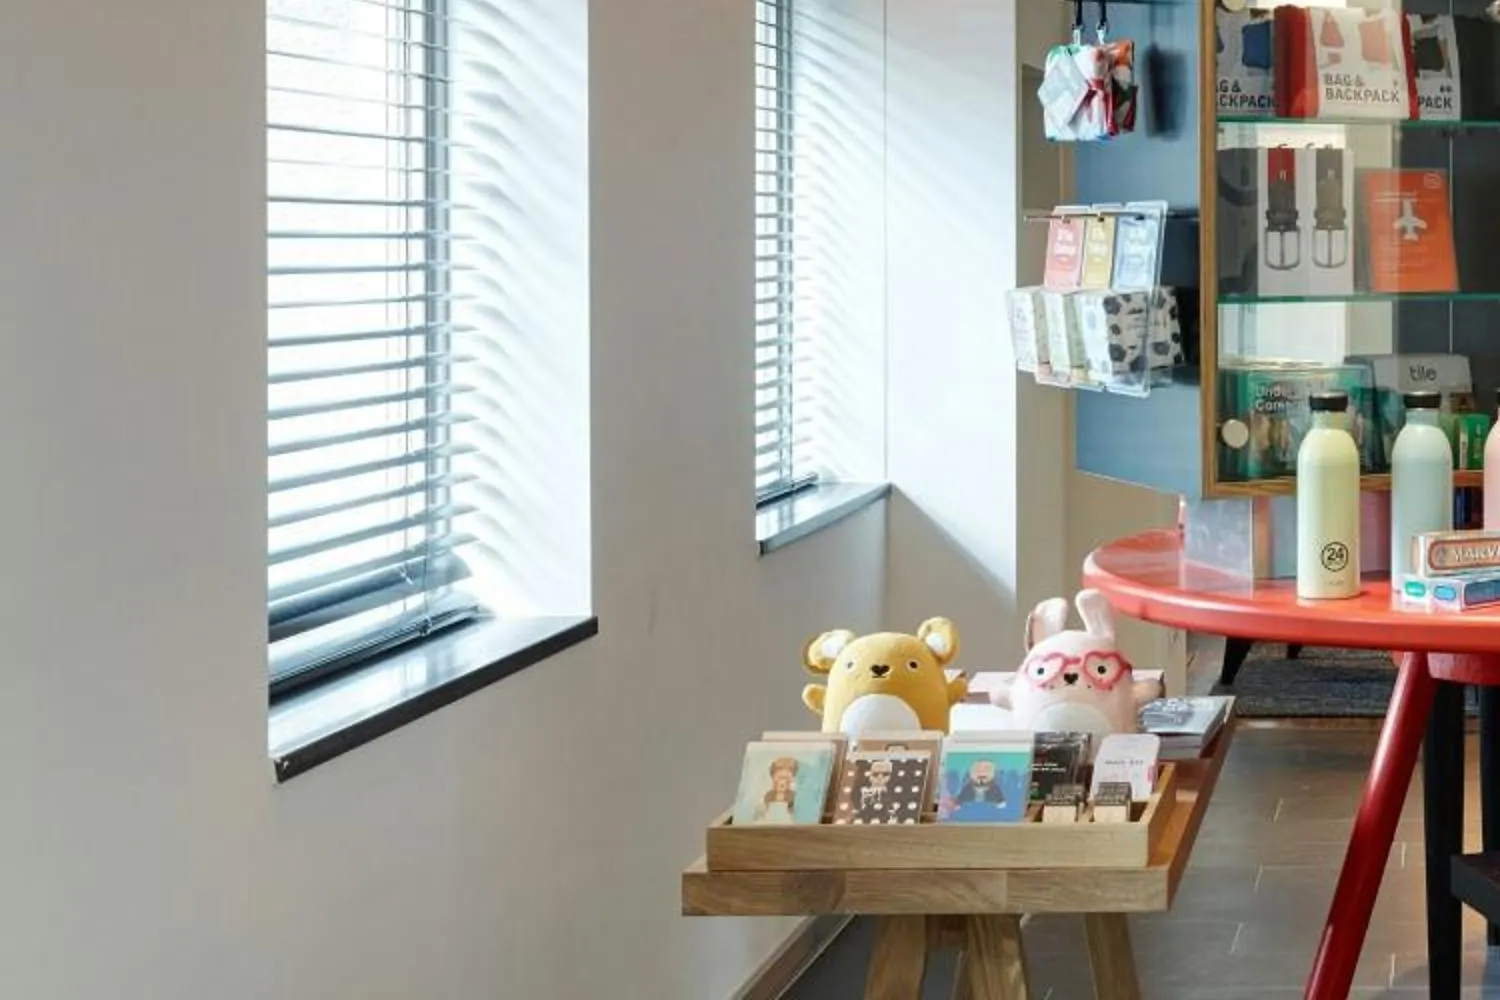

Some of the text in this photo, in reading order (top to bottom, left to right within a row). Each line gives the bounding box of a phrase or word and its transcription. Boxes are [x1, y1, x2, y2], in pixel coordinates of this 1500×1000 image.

[1232, 80, 1241, 93] &
[1324, 73, 1365, 87] BAG &
[1216, 93, 1279, 108] CKPACK
[1325, 87, 1400, 103] BACKPACK
[1409, 363, 1437, 381] tile
[1327, 547, 1344, 560] 24
